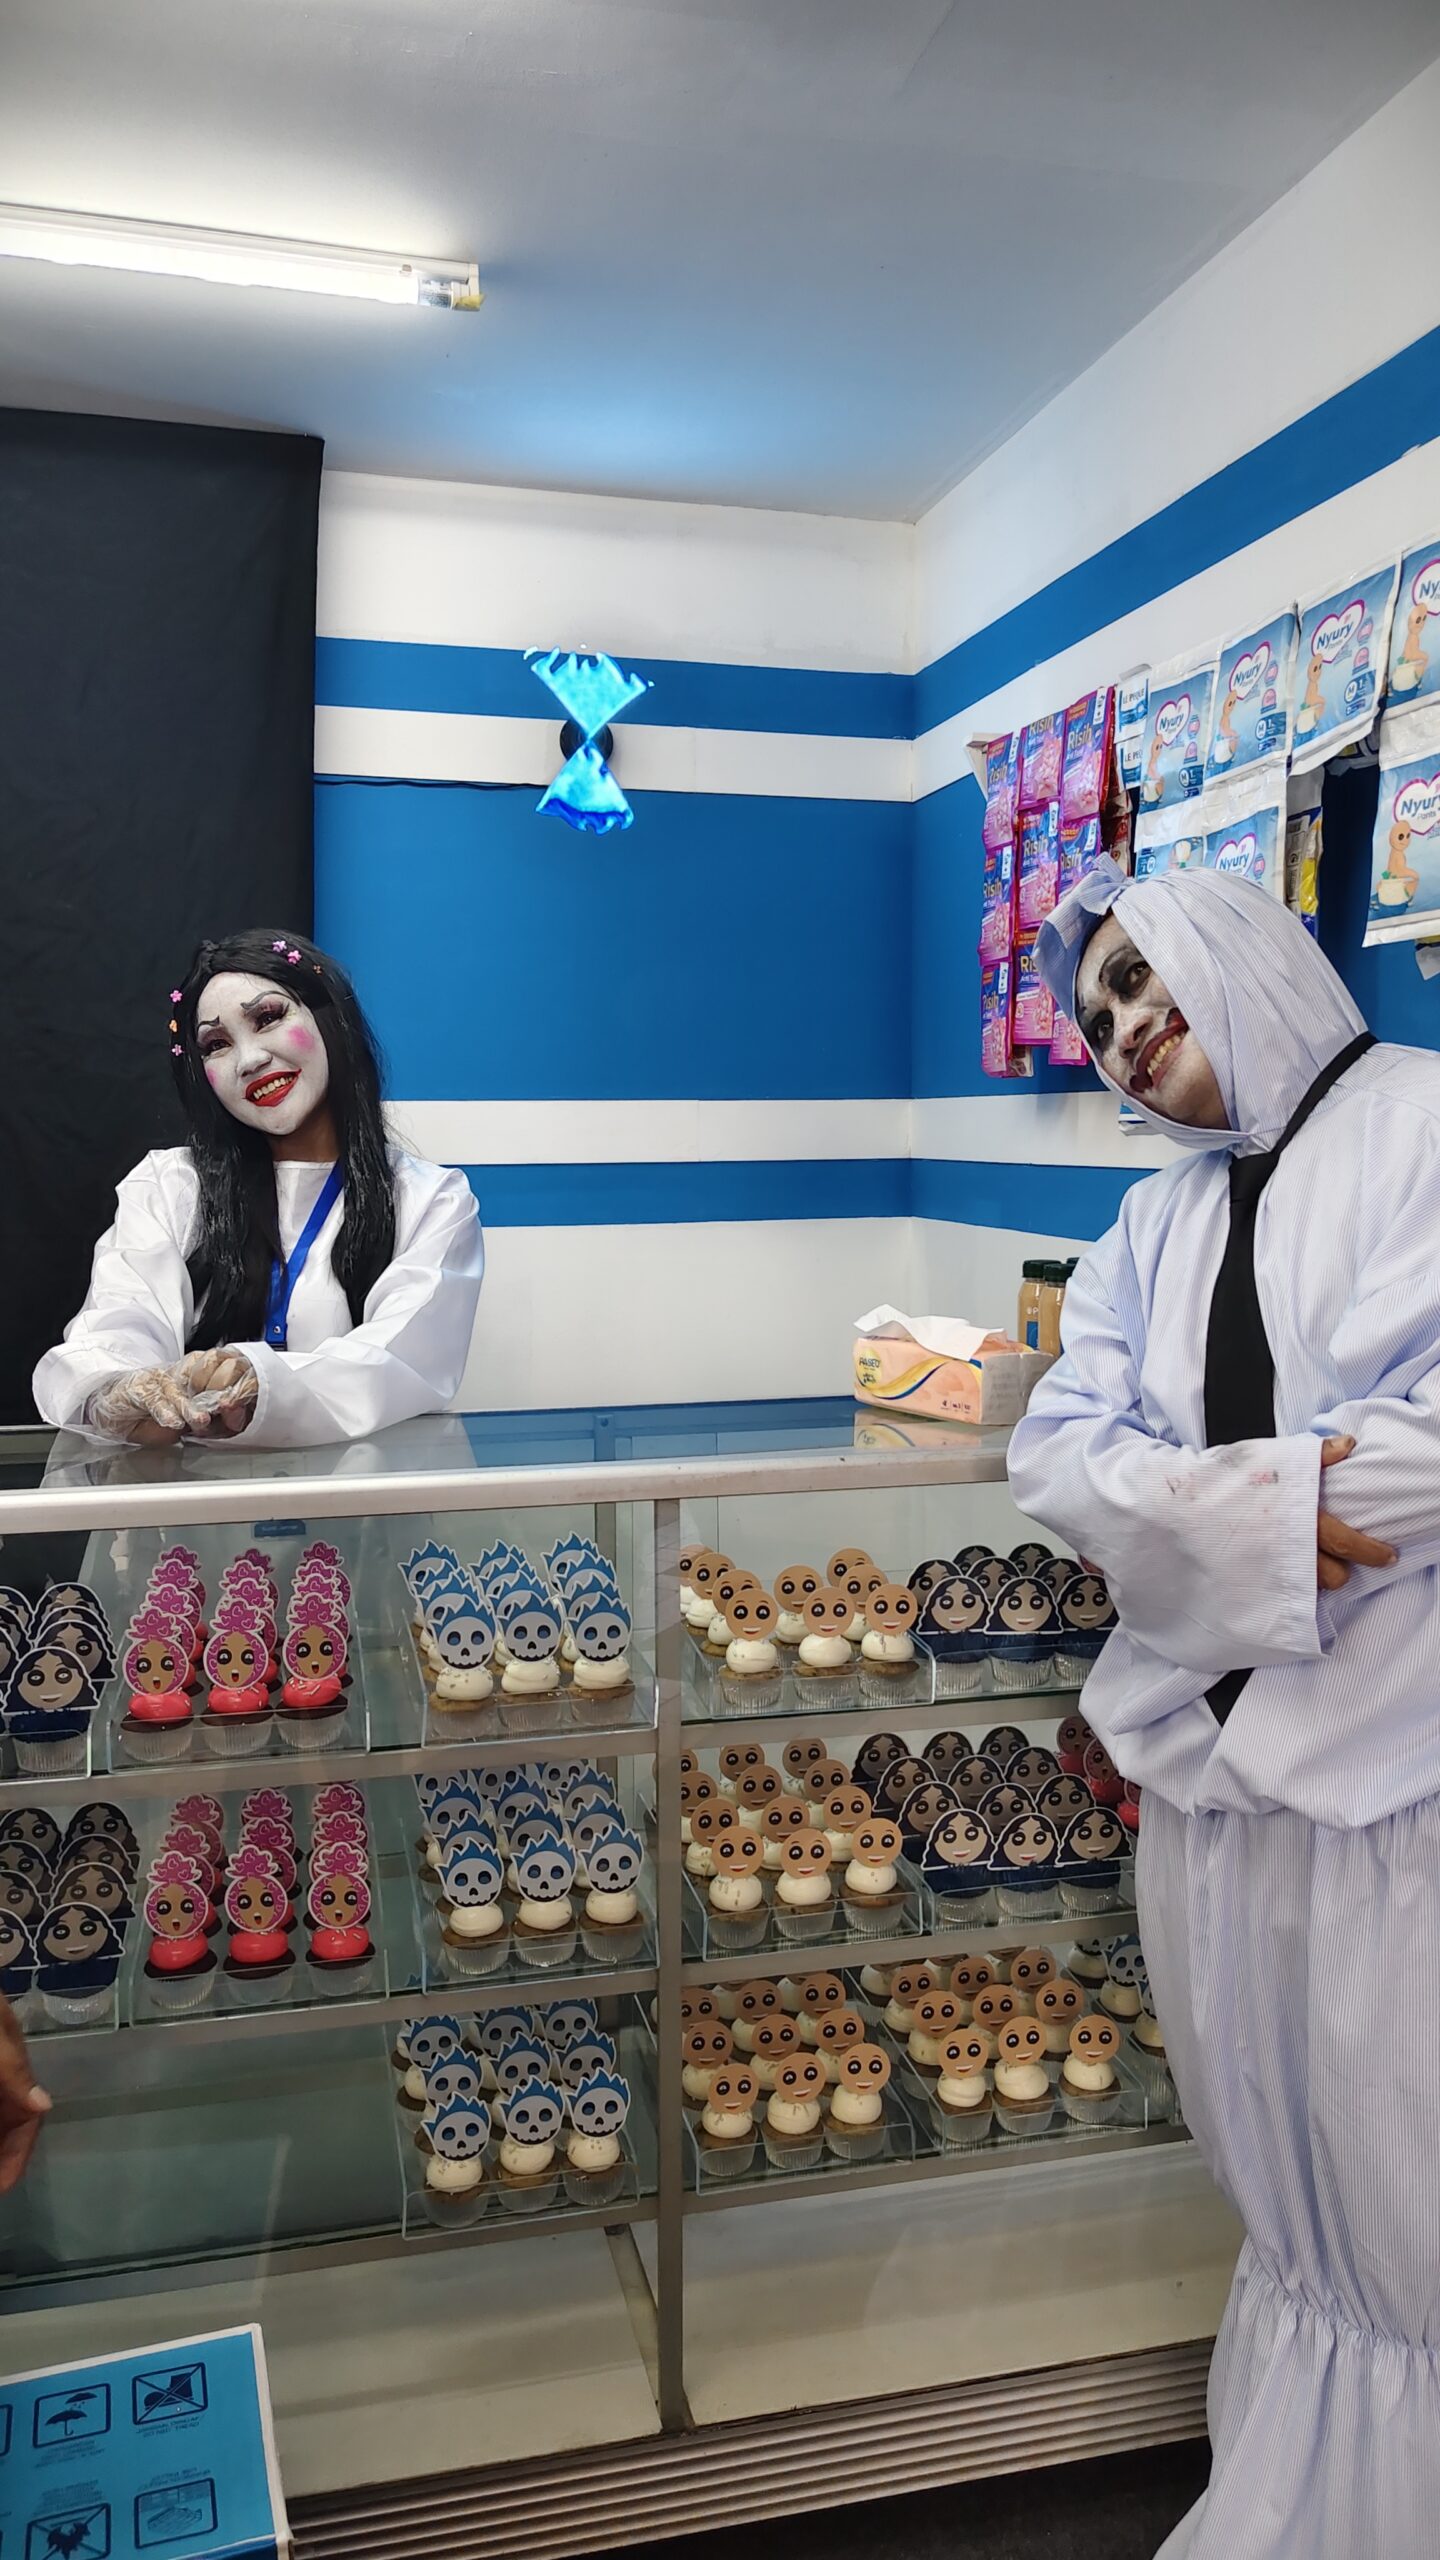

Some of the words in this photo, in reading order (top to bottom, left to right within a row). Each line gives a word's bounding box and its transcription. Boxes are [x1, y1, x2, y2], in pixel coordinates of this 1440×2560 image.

[1316, 621, 1353, 650] Nyury
[1234, 662, 1261, 686] Nyury
[1160, 713, 1184, 732] Nyury
[1068, 722, 1092, 749] Risih
[1400, 795, 1440, 817] Nyur
[1024, 835, 1048, 856] Risih
[1220, 852, 1250, 871] Nyury
[983, 878, 1002, 898] Risih
